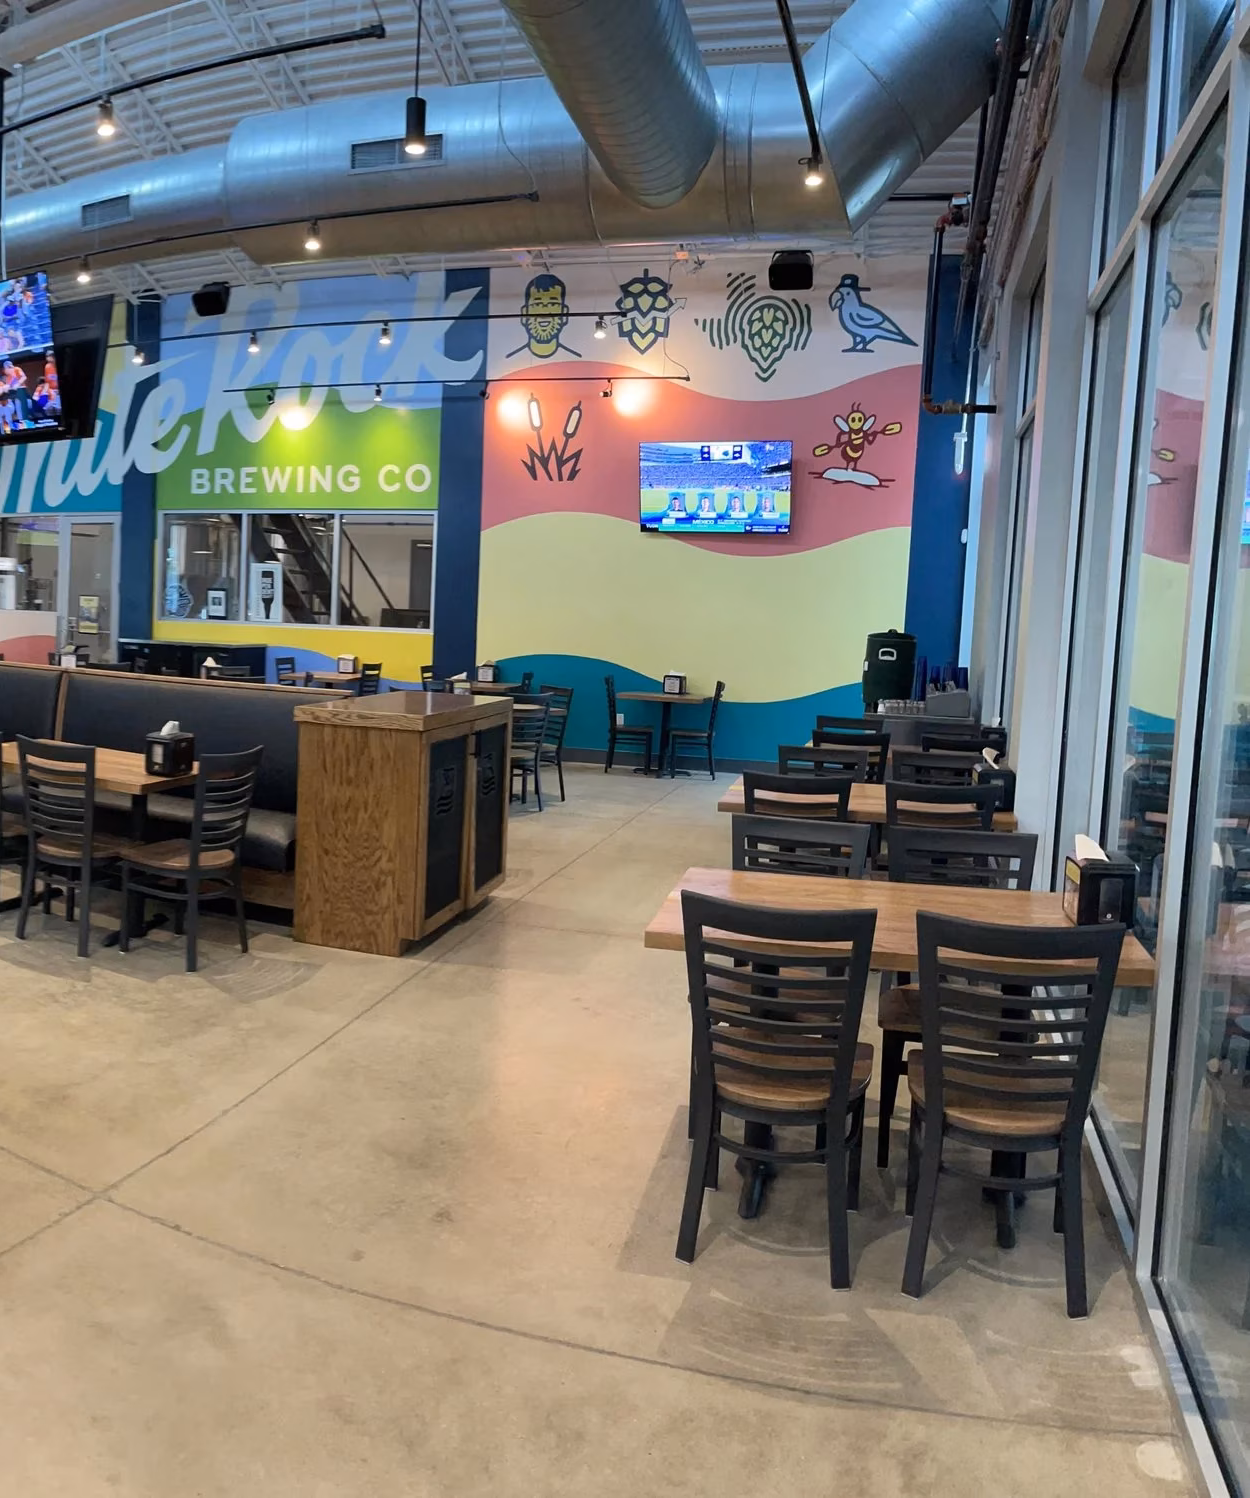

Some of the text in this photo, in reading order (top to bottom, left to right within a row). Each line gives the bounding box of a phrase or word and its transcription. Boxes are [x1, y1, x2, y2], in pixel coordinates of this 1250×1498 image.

[183, 271, 483, 457] Rock
[190, 462, 433, 495] BREWING CO
